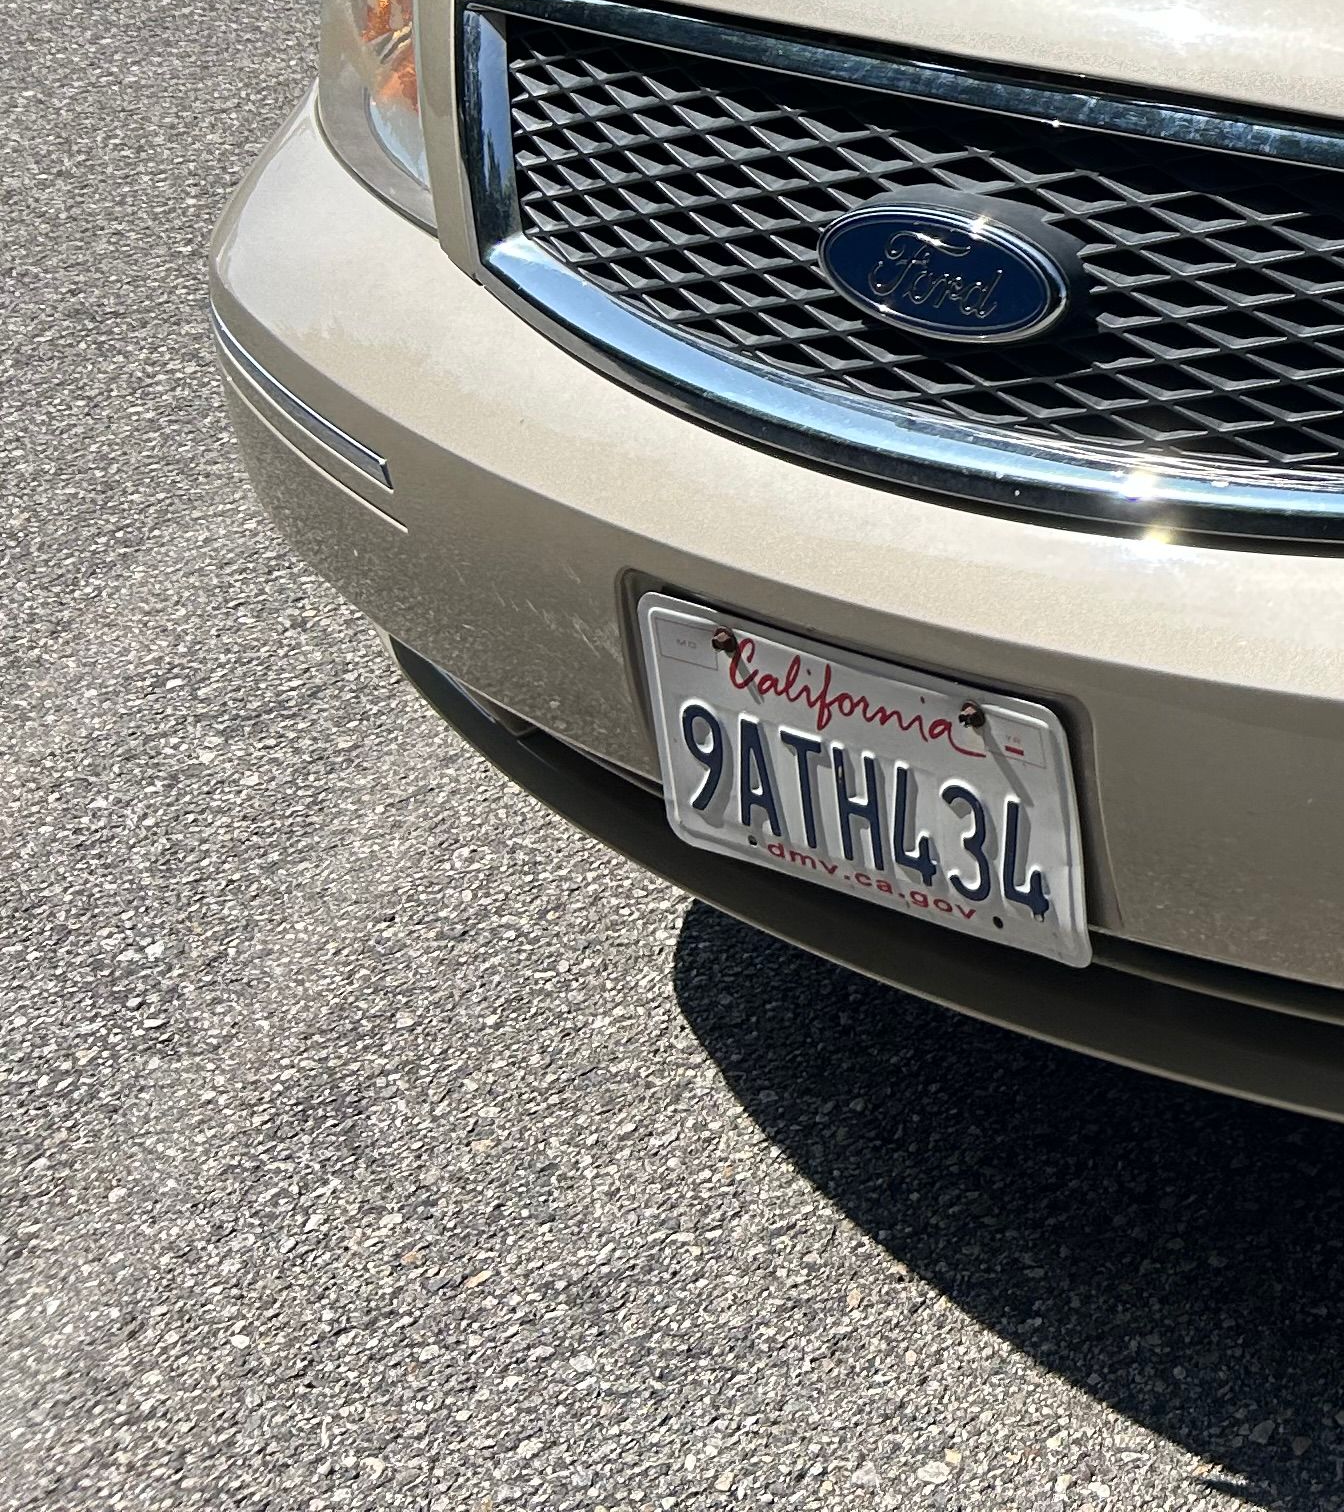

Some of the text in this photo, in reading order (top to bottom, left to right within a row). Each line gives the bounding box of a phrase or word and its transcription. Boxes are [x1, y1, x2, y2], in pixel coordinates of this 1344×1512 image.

[867, 229, 1003, 319] Ford
[729, 638, 986, 758] California
[682, 700, 1050, 920] 9ATH434
[766, 841, 977, 920] dmv.ca.gov
